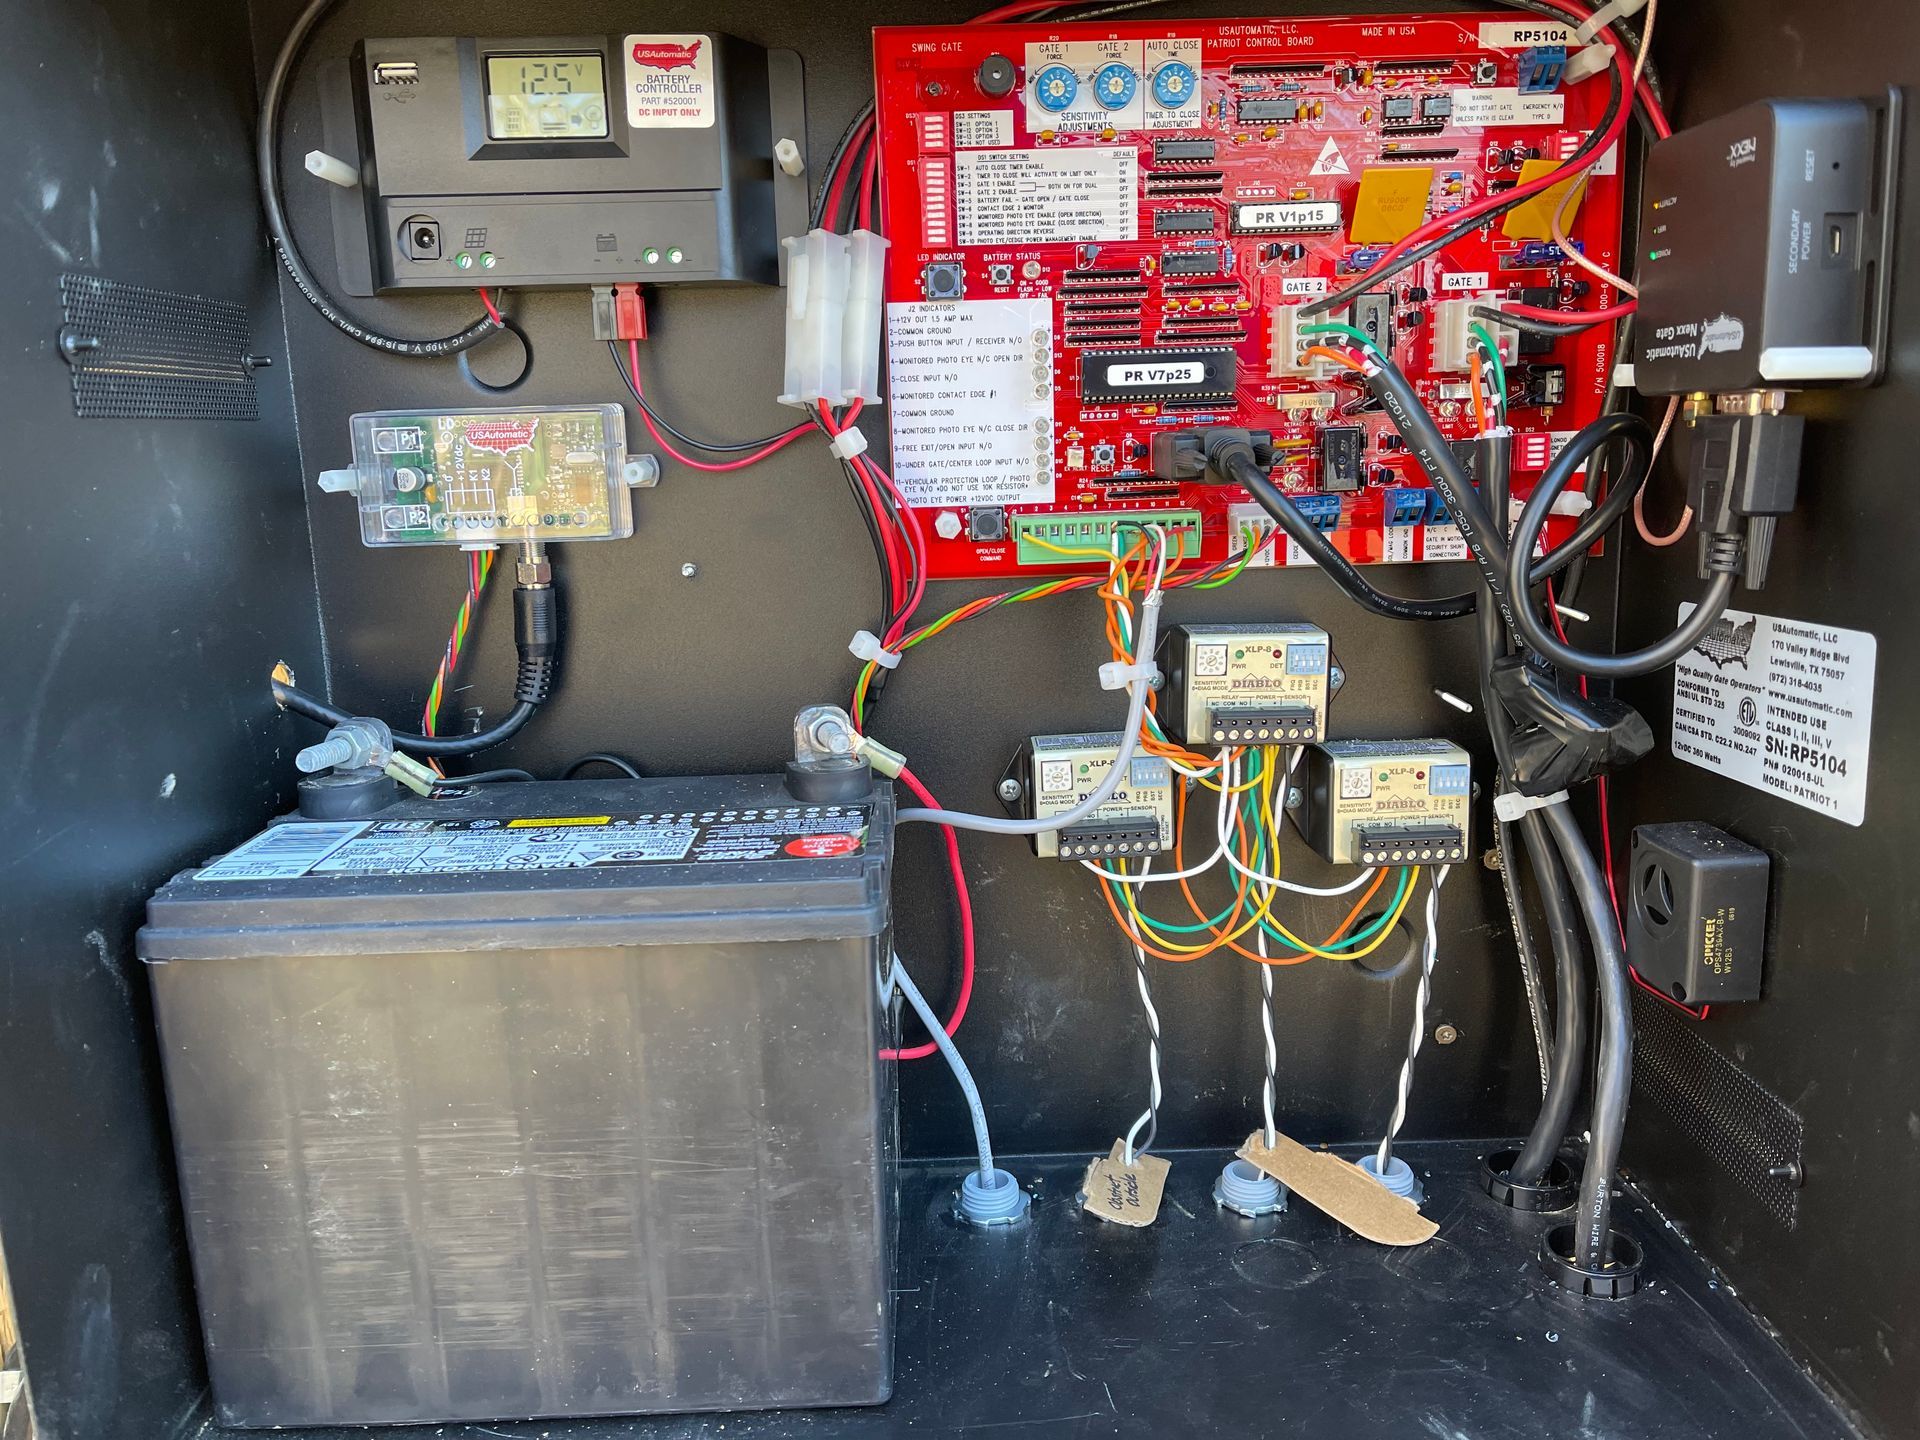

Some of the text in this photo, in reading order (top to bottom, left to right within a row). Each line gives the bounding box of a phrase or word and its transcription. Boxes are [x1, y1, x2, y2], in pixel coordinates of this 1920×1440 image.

[1219, 24, 1299, 35] USAUTOMATIC, LLC.
[1362, 26, 1416, 37] MADE IN USA
[1207, 36, 1314, 48] PATRIOT CONTROL BOARD
[1457, 33, 1476, 44] S/N
[1513, 30, 1568, 42] RP5104
[911, 41, 963, 53] SWING GATE
[1038, 43, 1069, 53] GATE 1
[1097, 42, 1129, 52] GATE 2
[1147, 40, 1199, 51] AUTO CLOSE
[637, 50, 692, 58] USAutomatic
[522, 63, 583, 95] 12.5 V
[646, 75, 691, 84] BATTERY
[636, 83, 702, 93] CONTROLLER
[641, 97, 697, 105] PART #520001
[639, 108, 702, 117] DC INPUT ONLY
[1061, 111, 1109, 122] SENSITIVITY
[1145, 112, 1166, 120] TIMER
[1177, 111, 1200, 119] CLOSE
[1057, 122, 1113, 132] ADJUSTMENTS
[1152, 120, 1193, 129] ADJUSTMENT
[1729, 137, 1757, 159] NEXX
[1804, 149, 1815, 182] RESET
[1255, 209, 1324, 225] PR V1p15
[1788, 208, 1800, 274] SECONDARY
[1801, 221, 1811, 261] POWER
[917, 253, 966, 262] LED INDICATOR
[984, 252, 1041, 262] BATTERY STATUS
[1286, 281, 1323, 292] GATE 2
[1448, 276, 1482, 287] GATE 1
[320, 305, 336, 321] NO.
[908, 304, 956, 313] J2 INDICATORS
[338, 320, 361, 337] CM/L
[889, 327, 952, 337] 2-COMMON GROUND
[1655, 322, 1698, 341] Nexx Gate
[425, 342, 448, 352] 1100
[889, 340, 915, 348] 3-PUSH
[918, 339, 943, 347] BUTTON
[975, 337, 1006, 345] RECEIVER
[1645, 344, 1697, 361] USAutomatic
[1595, 343, 1606, 394] P/N 500018
[891, 375, 920, 383] 5-CLOSE
[923, 374, 941, 382] INPUT
[1124, 369, 1192, 383] PR V7p25
[893, 410, 927, 418] 7-COMMON
[1384, 391, 1412, 429] 21020
[401, 433, 420, 446] P1
[471, 430, 529, 440] USAutomatic
[894, 444, 918, 452] 9-FREE
[921, 443, 955, 452] EXIT/OPEN
[958, 442, 976, 450] INPUT
[455, 444, 466, 480] +12Vdc
[1419, 448, 1437, 471] FT4
[1091, 464, 1115, 472] RESET
[470, 470, 478, 481] K1
[482, 468, 490, 481] K2
[409, 512, 427, 524] P2
[1455, 509, 1474, 538] 105C
[1772, 622, 1838, 643] USAutomatic, LLC
[1245, 645, 1272, 653] XLP-8
[1771, 639, 1850, 664] 170 Valley Ridge Blvd
[1270, 662, 1284, 670] DET
[1770, 656, 1846, 680] Lewisville, TX 75057
[1693, 669, 1714, 682] Quality
[1714, 674, 1729, 685] Gate
[1769, 672, 1823, 692] (972) 318-4035
[1231, 679, 1282, 689] DIABLO
[1677, 679, 1720, 698] CONFORMS TO
[1700, 695, 1713, 706] STD
[1713, 699, 1725, 710] 325
[1767, 690, 1853, 719] www.usautomatic.com
[1675, 707, 1716, 727] CERTIFIED TO
[1766, 705, 1827, 731] INTENDED USE
[1700, 730, 1714, 742] STD.
[1733, 725, 1761, 742] 3009092
[1766, 721, 1792, 736] CLASS
[1826, 738, 1832, 749] V
[1704, 752, 1721, 765] Watts
[1763, 757, 1825, 787] PN# 020018-UL
[1762, 773, 1838, 810] MODEL: PATRIOT 1
[1376, 799, 1426, 809] DIABLO
[1592, 1176, 1607, 1219] BURTON
[1591, 1223, 1600, 1247] WIRE
